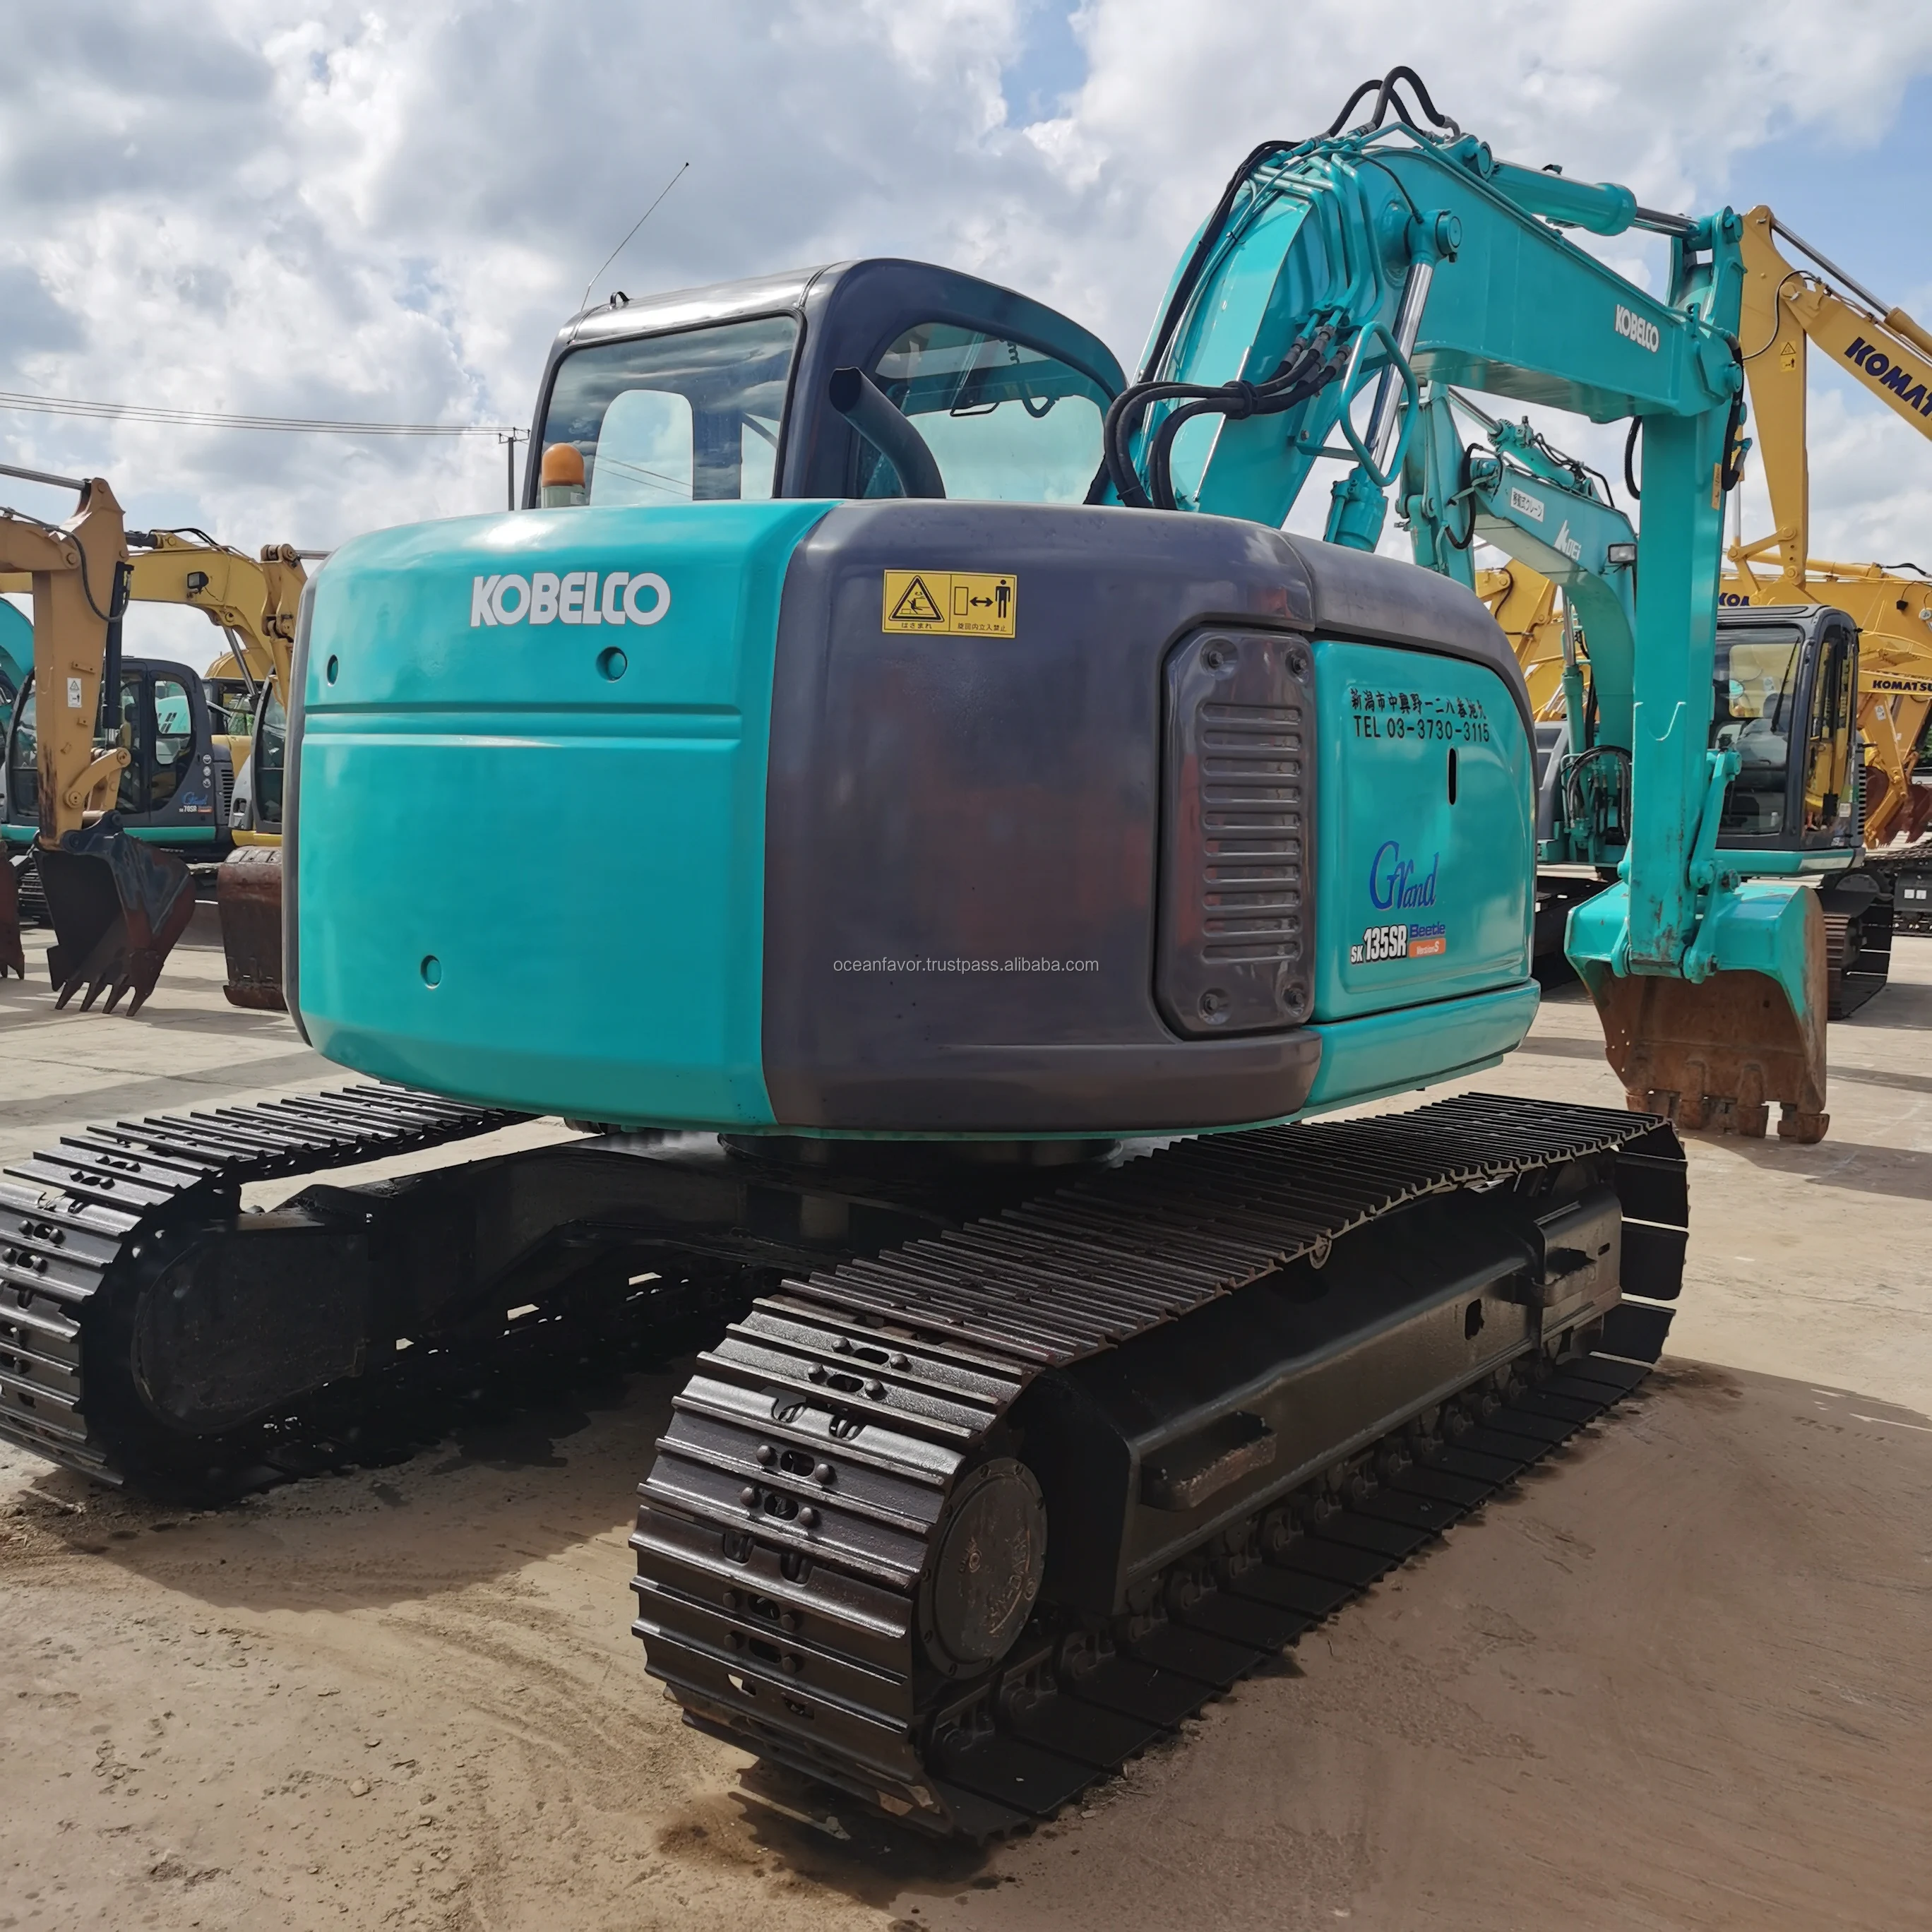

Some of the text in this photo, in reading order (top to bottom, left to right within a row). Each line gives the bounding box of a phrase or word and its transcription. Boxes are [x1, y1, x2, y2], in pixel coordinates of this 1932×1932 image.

[1615, 303, 1659, 353] KOBELCO
[470, 571, 671, 627] KOBELCO
[1353, 715, 1490, 742] TEL 03-3730-3115
[1370, 840, 1439, 910] Grand
[1409, 922, 1445, 938] Beetle
